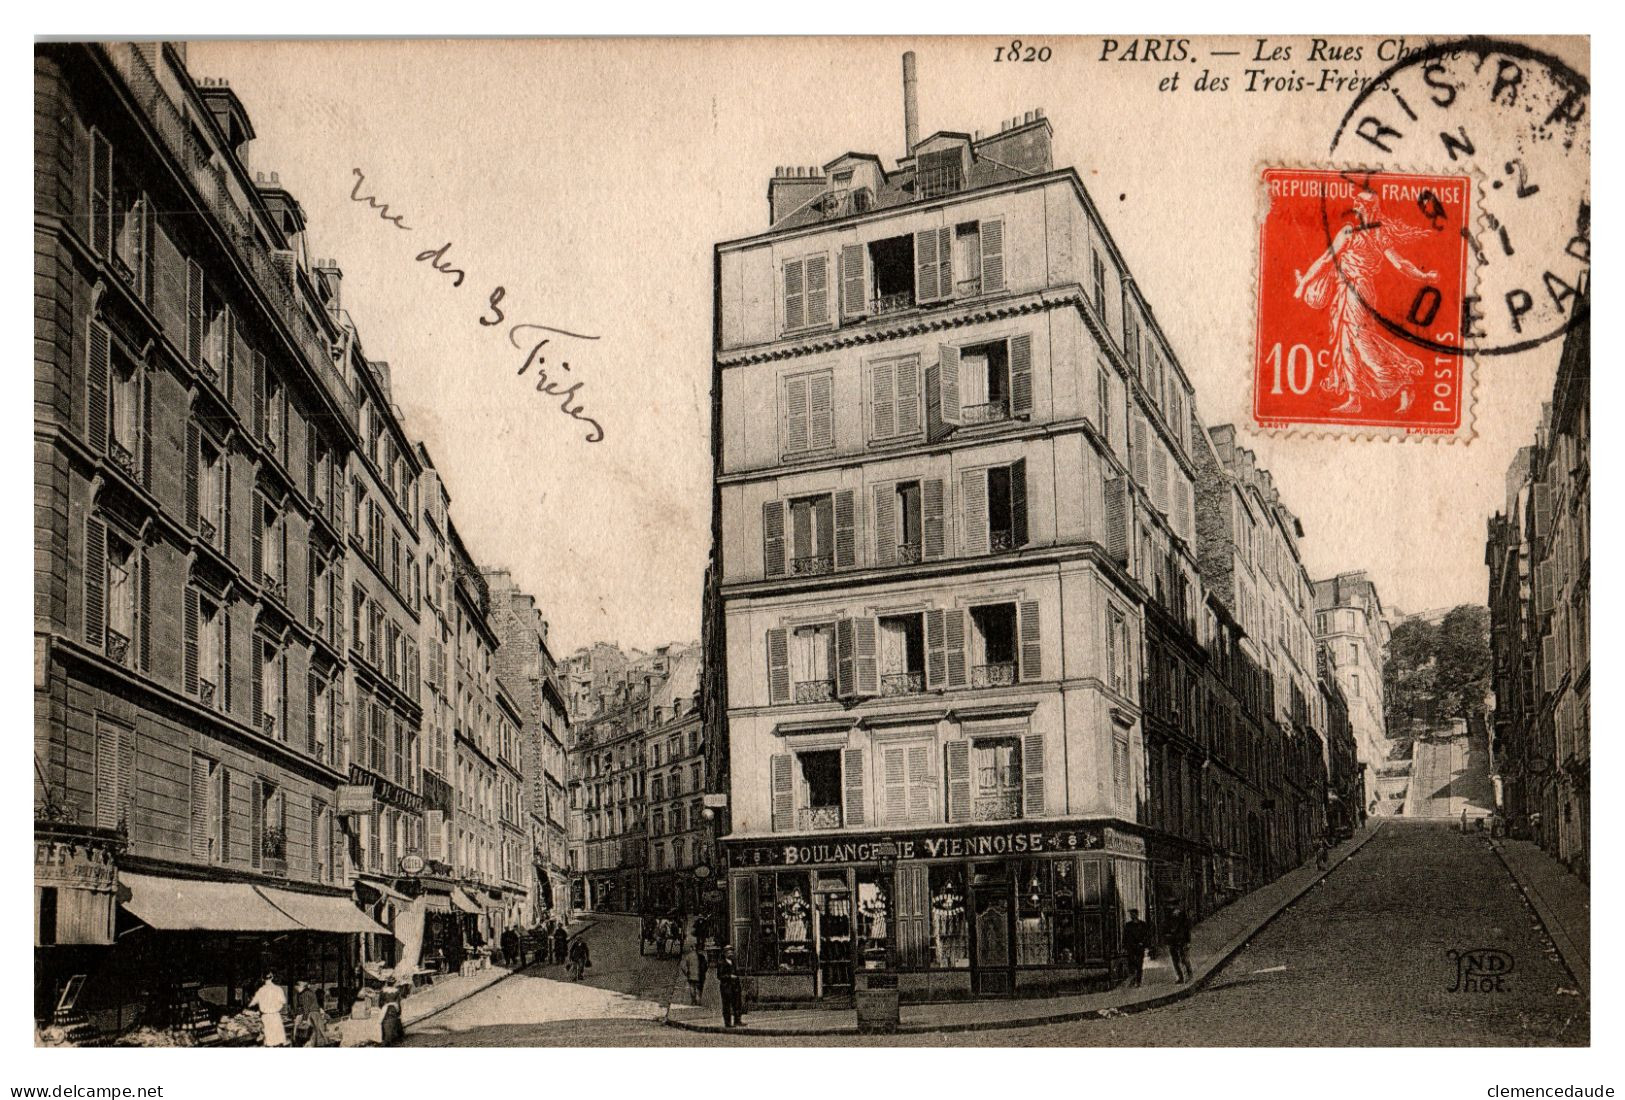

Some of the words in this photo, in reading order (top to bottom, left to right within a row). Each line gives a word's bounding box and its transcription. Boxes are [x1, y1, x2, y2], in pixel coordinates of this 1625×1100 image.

[479, 286, 505, 326] 3
[1432, 331, 1455, 412] POSTS
[783, 841, 915, 865] BOULANGEIE
[924, 832, 1043, 858] VIENNOISE
